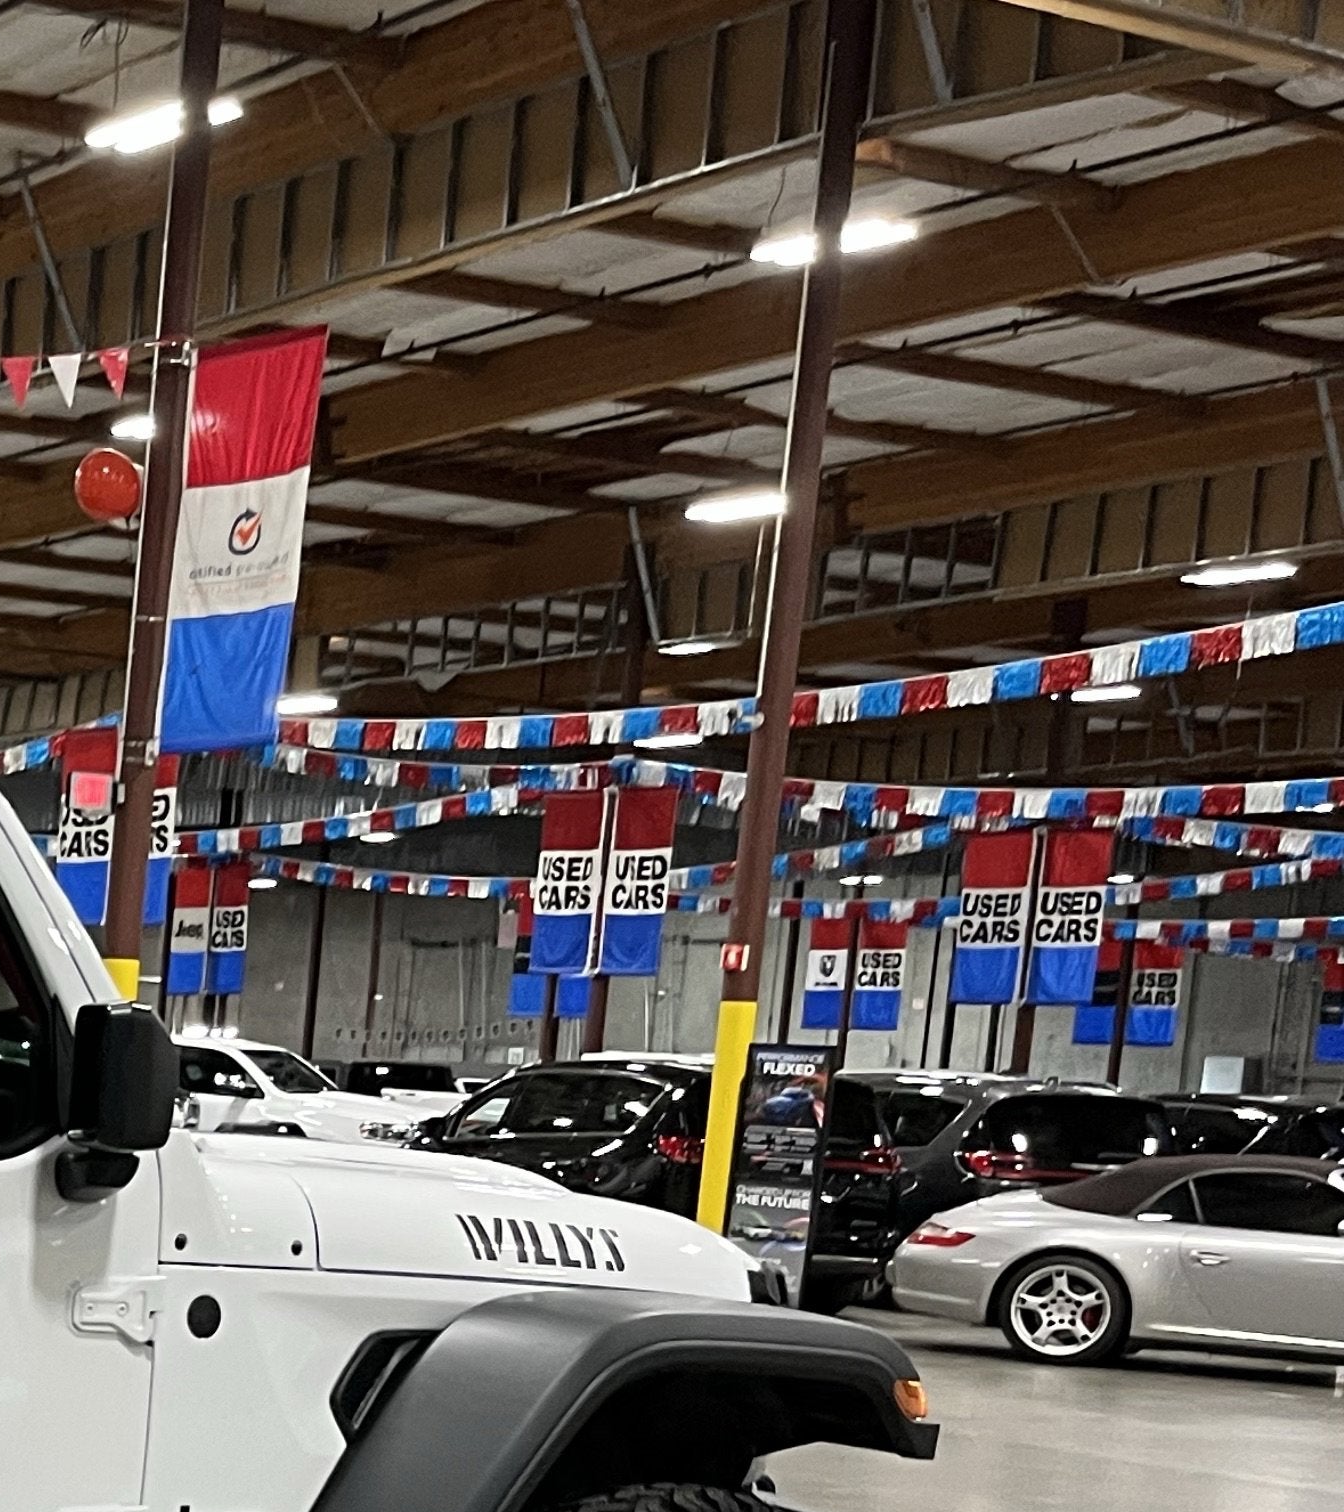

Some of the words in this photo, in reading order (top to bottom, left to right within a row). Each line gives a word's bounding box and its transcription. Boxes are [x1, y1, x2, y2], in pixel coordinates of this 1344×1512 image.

[542, 856, 594, 882] USED
[538, 884, 592, 911] CARS
[611, 882, 666, 910] CARS
[962, 892, 1022, 918] USED
[1040, 890, 1103, 916] USED
[959, 918, 1021, 944] CARS
[1035, 918, 1099, 943] CARS
[861, 952, 903, 969] USED
[858, 971, 901, 987] CARS
[763, 1062, 816, 1077] FLEXED
[736, 1194, 760, 1206] THE
[761, 1195, 810, 1211] FUTURE
[455, 1213, 626, 1272] WILLYS
